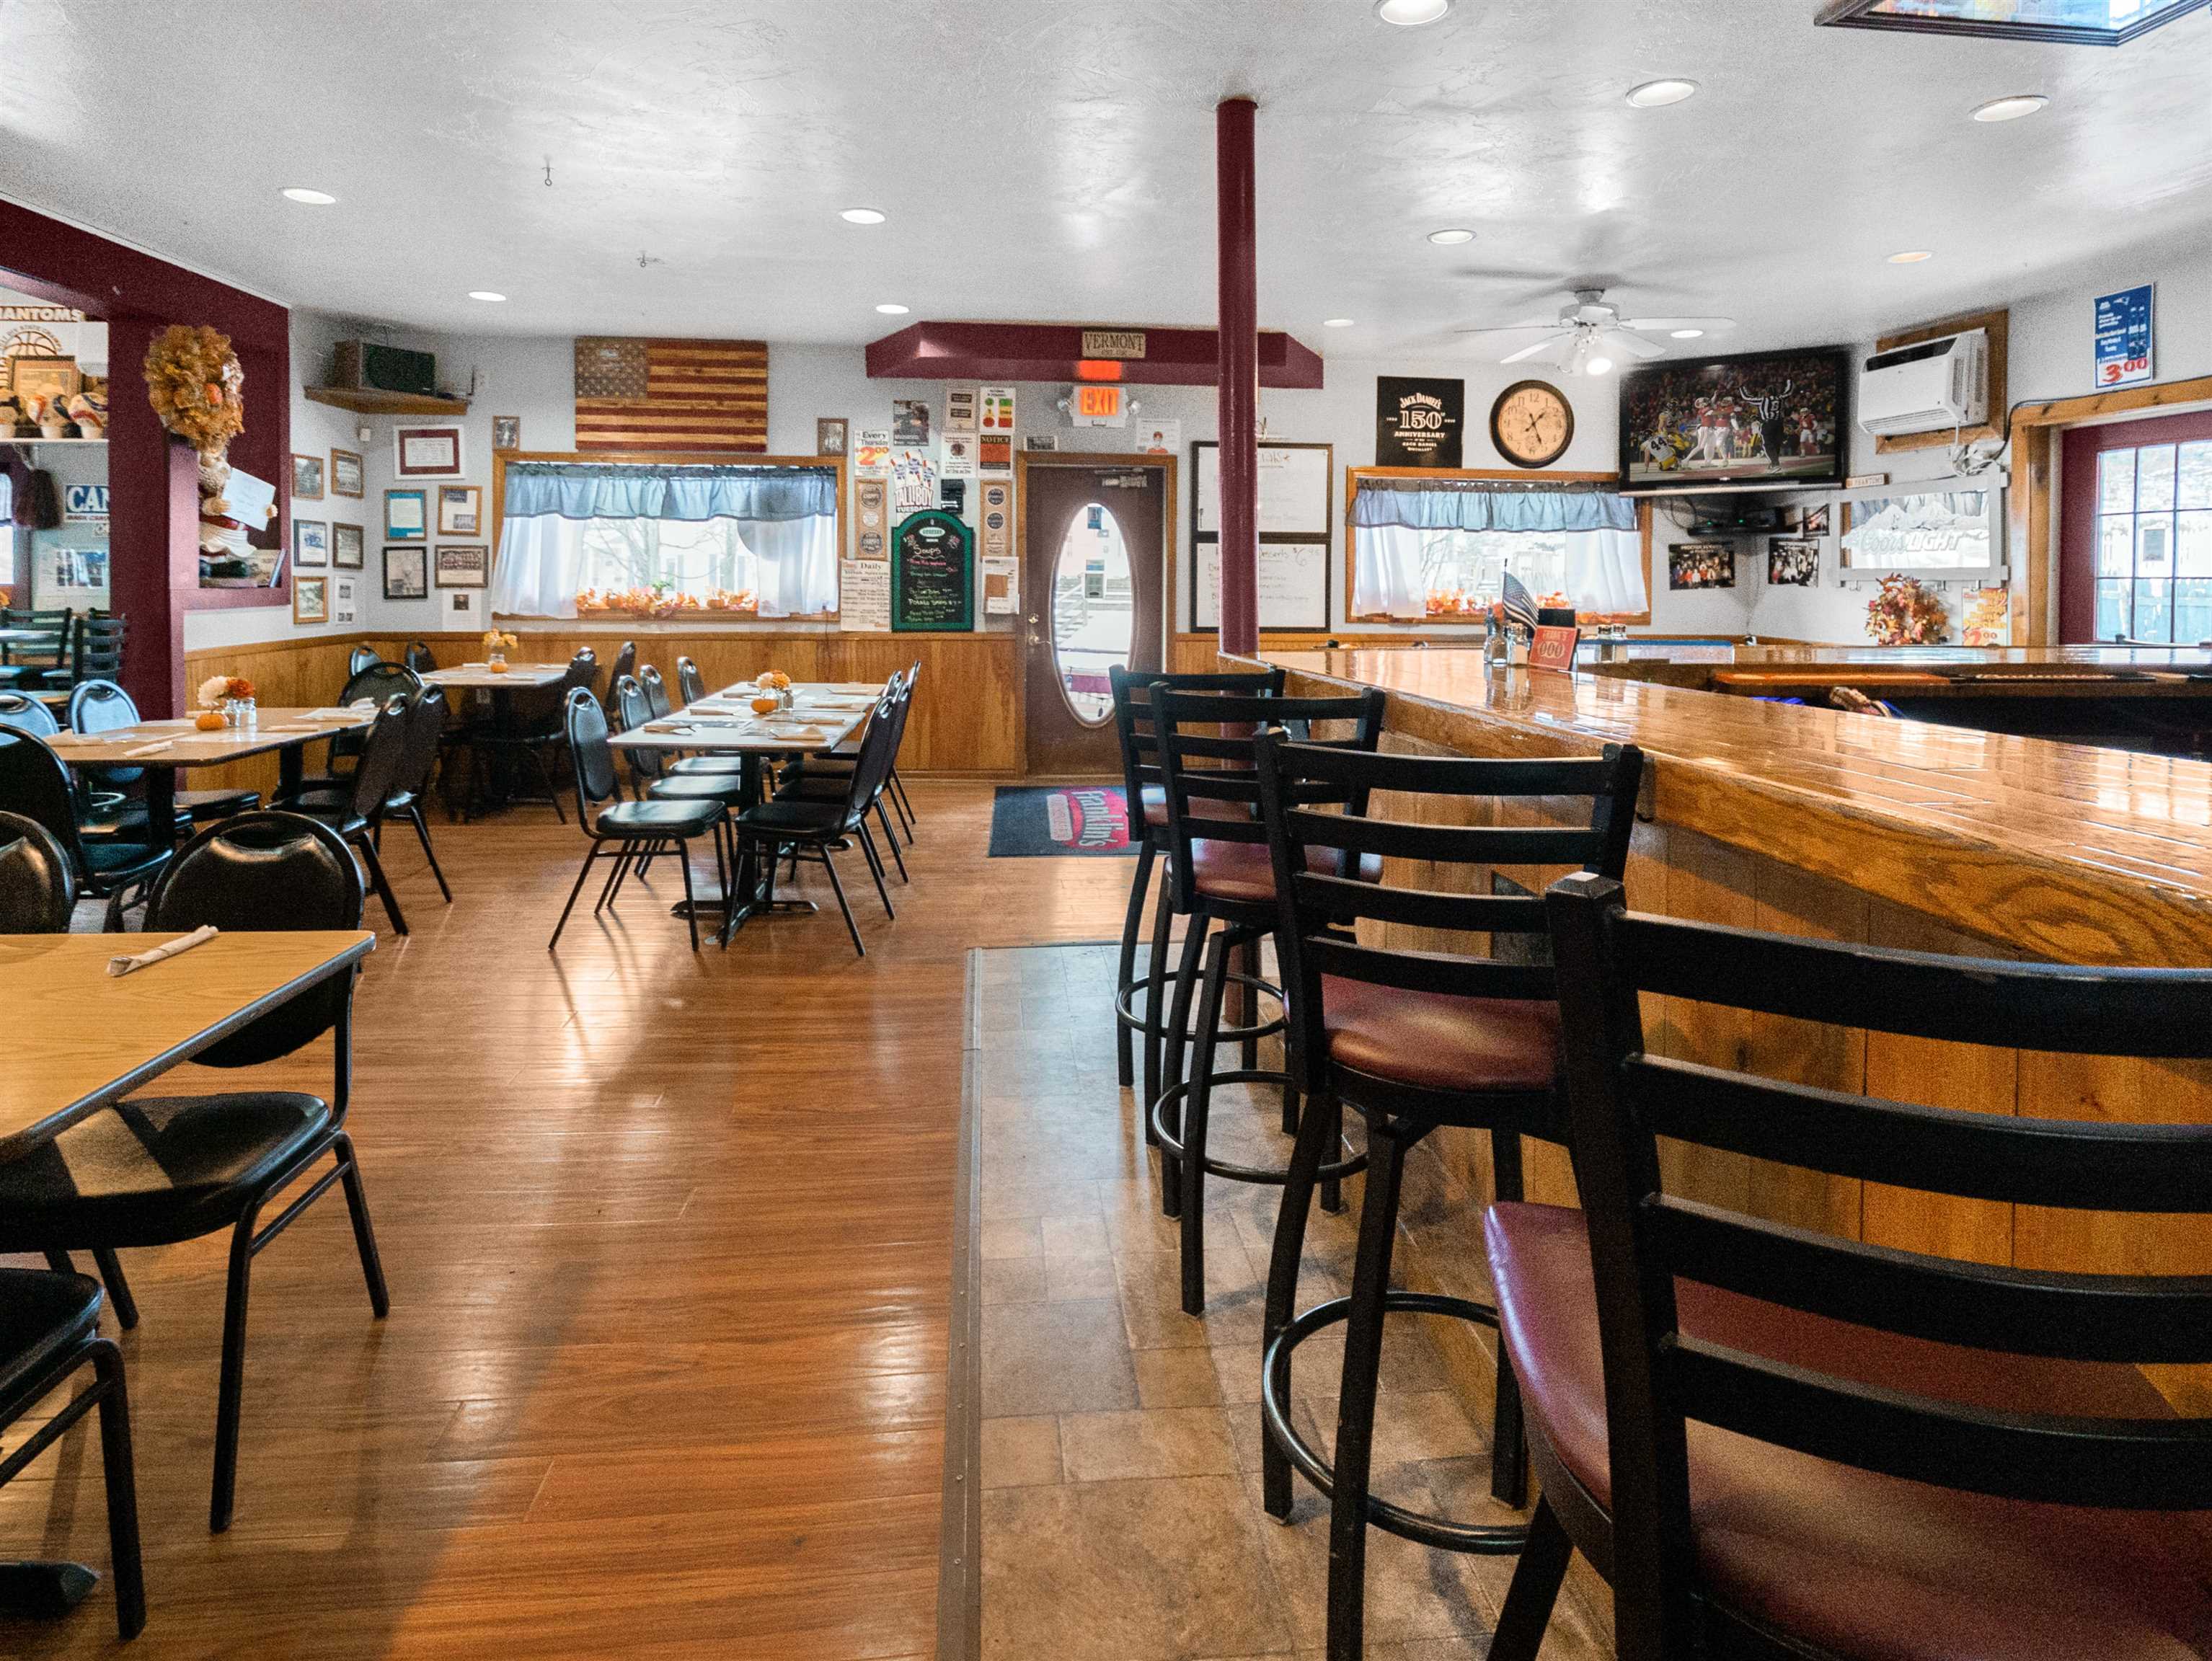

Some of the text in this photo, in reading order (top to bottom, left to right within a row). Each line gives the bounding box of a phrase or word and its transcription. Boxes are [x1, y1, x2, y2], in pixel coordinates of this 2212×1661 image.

[1084, 334, 1143, 351] VERMONT
[1084, 388, 1118, 415] EXIT
[1399, 395, 1417, 409] JACK
[1529, 393, 1540, 403] 12
[1906, 530, 1963, 552] LIGHT
